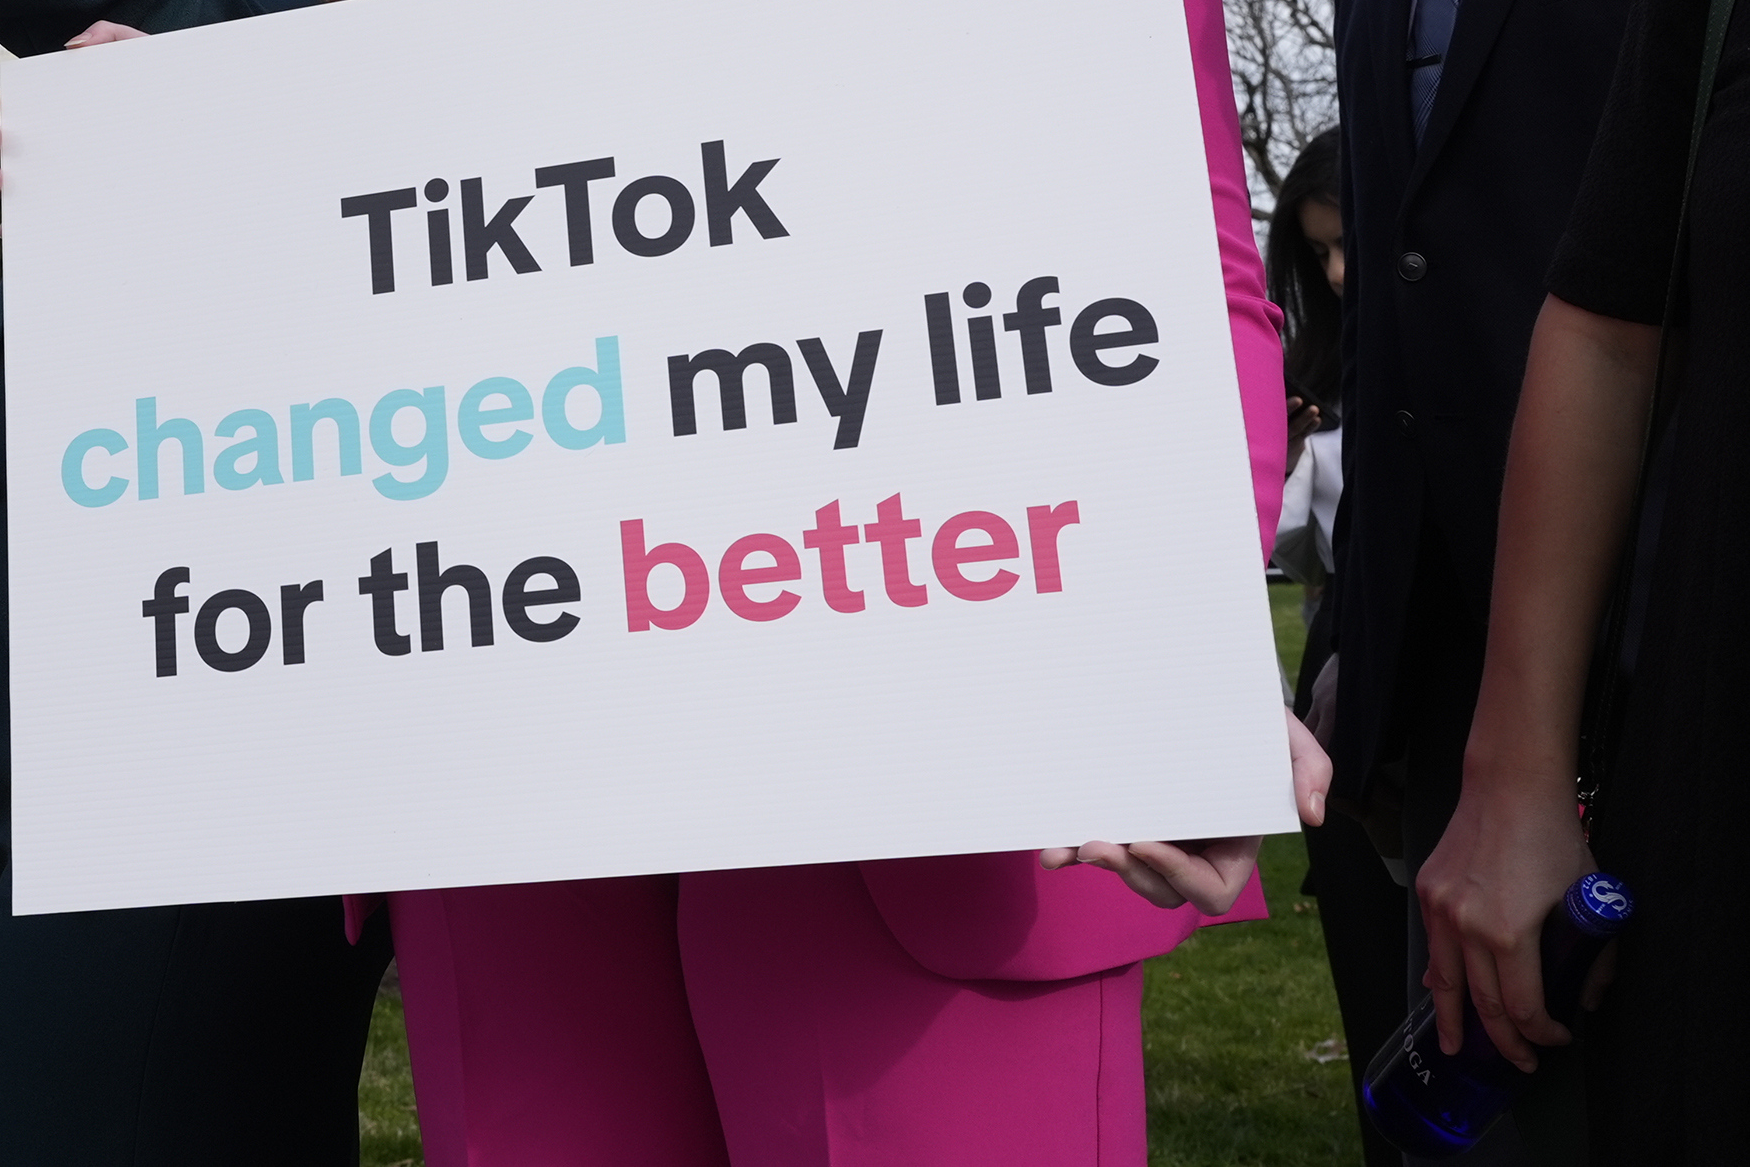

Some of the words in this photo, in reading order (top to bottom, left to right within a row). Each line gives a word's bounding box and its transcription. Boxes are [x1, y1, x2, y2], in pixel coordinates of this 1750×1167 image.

[341, 140, 791, 296] TikTok
[62, 336, 627, 509] changed
[667, 329, 884, 451] my
[924, 276, 1161, 407] life
[142, 566, 325, 679] for
[358, 541, 582, 657] the
[620, 492, 1081, 633] better
